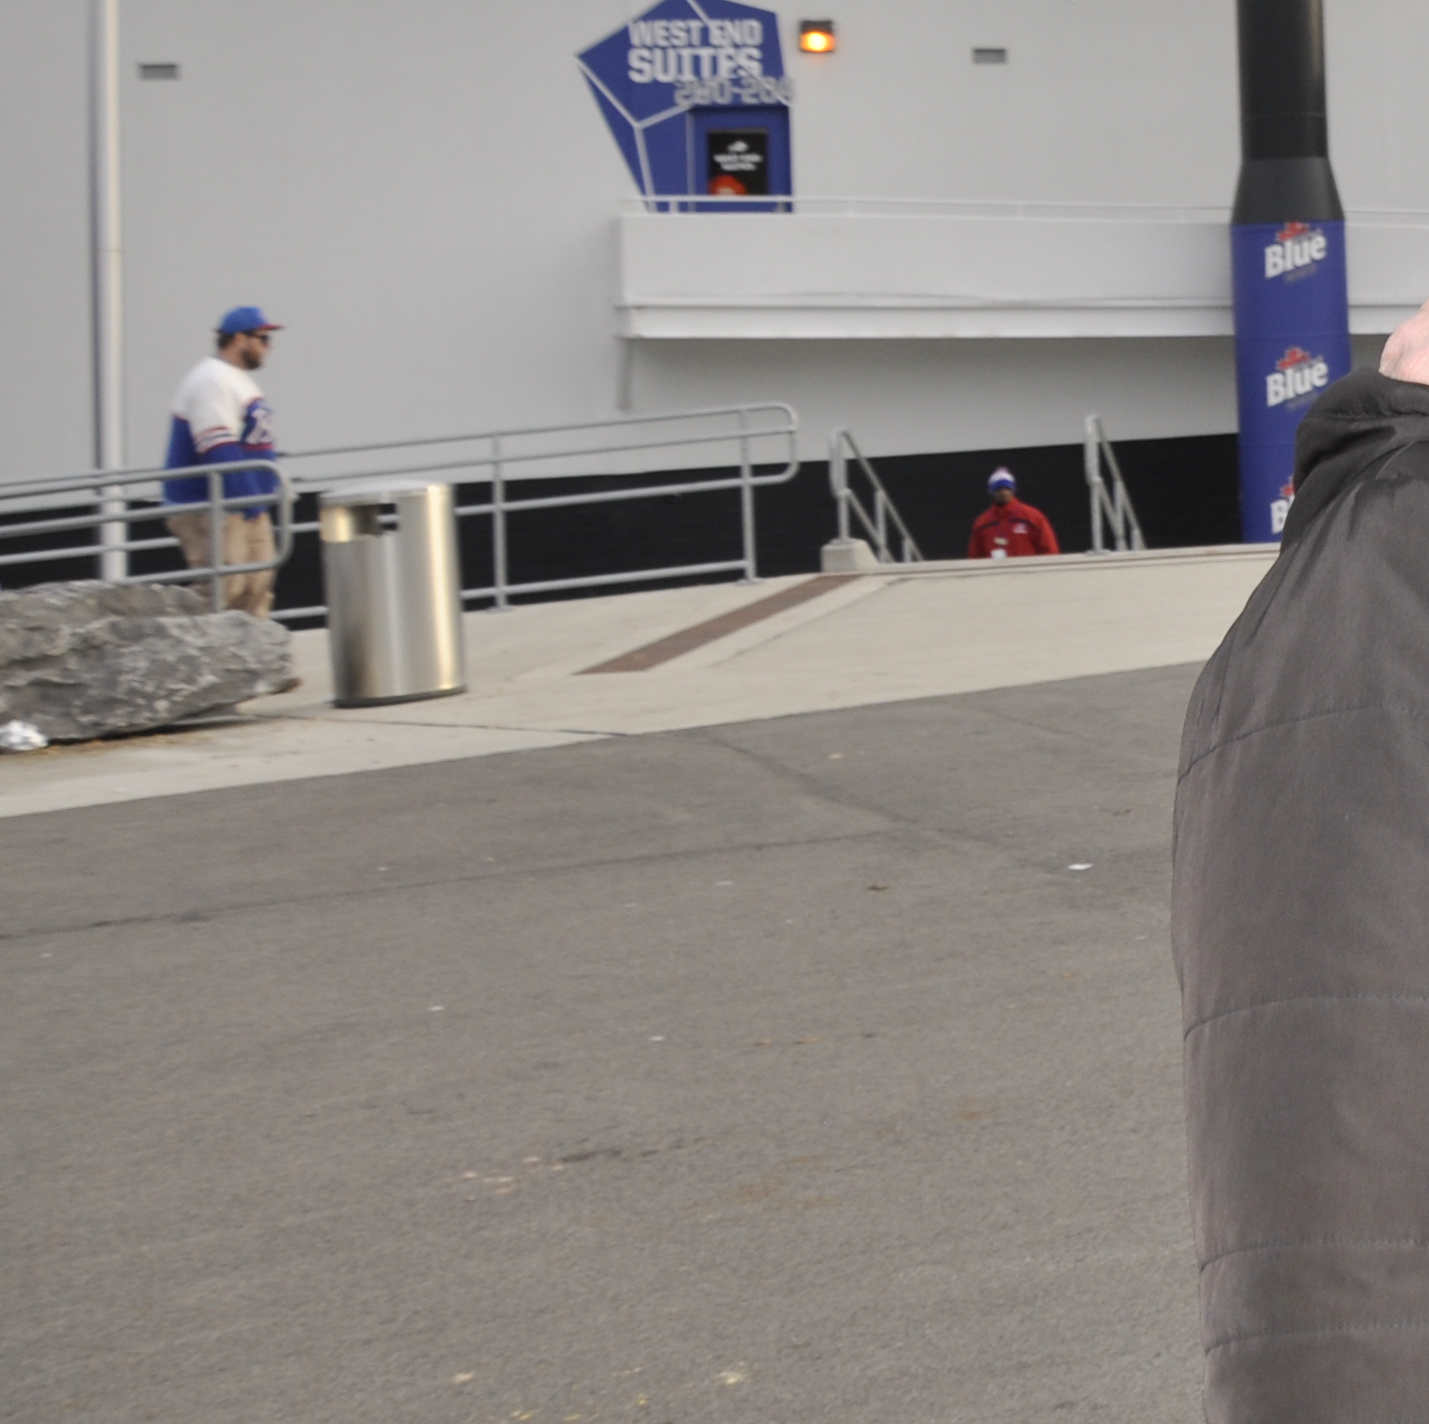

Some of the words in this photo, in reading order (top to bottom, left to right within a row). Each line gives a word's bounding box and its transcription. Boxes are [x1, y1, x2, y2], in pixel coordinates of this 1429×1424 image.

[627, 18, 702, 47] WEST
[707, 18, 764, 47] END
[626, 46, 764, 84] SUITES
[1264, 232, 1327, 279] Blue
[1265, 360, 1329, 408] Blue
